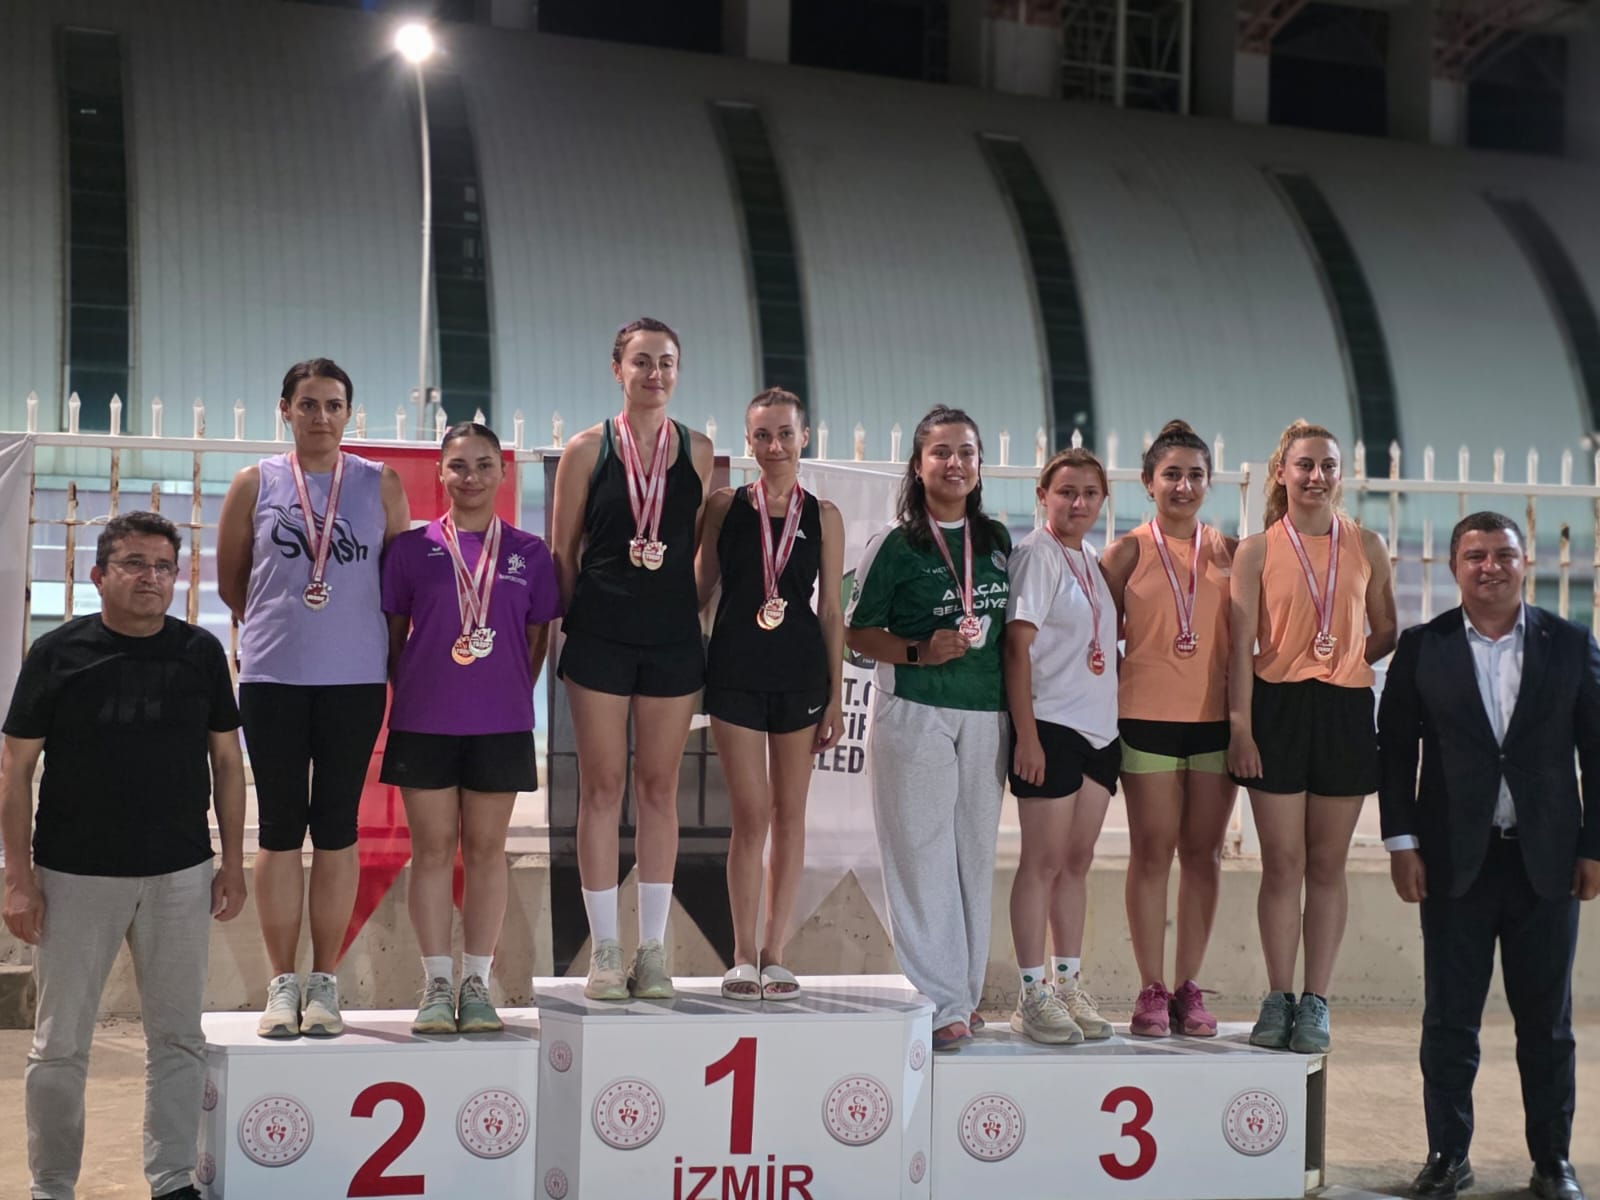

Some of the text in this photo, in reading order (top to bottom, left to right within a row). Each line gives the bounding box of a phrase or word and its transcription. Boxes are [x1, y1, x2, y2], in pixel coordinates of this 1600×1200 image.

[932, 597, 1009, 617] BELDİYE
[347, 1081, 426, 1198] 2
[704, 1037, 758, 1155] 1
[1098, 1085, 1158, 1181] 3
[673, 1154, 815, 1200] İZMİR
